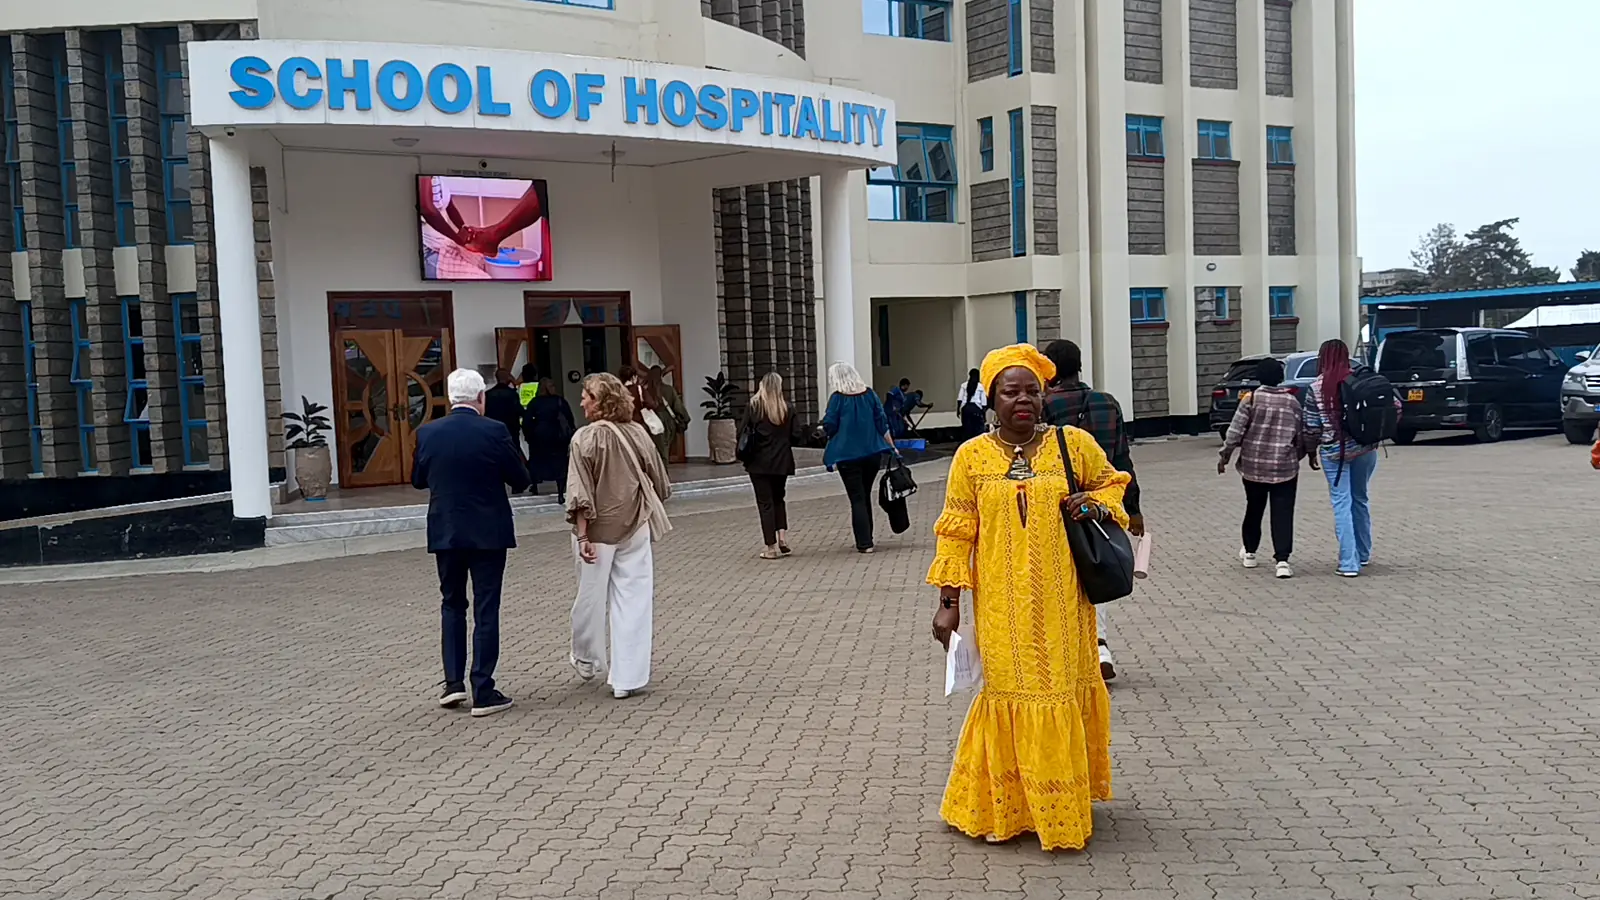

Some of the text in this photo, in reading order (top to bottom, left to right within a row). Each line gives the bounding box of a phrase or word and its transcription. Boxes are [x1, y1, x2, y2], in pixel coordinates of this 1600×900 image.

[228, 56, 886, 147] SCHOOL OF HOSPITALITY
